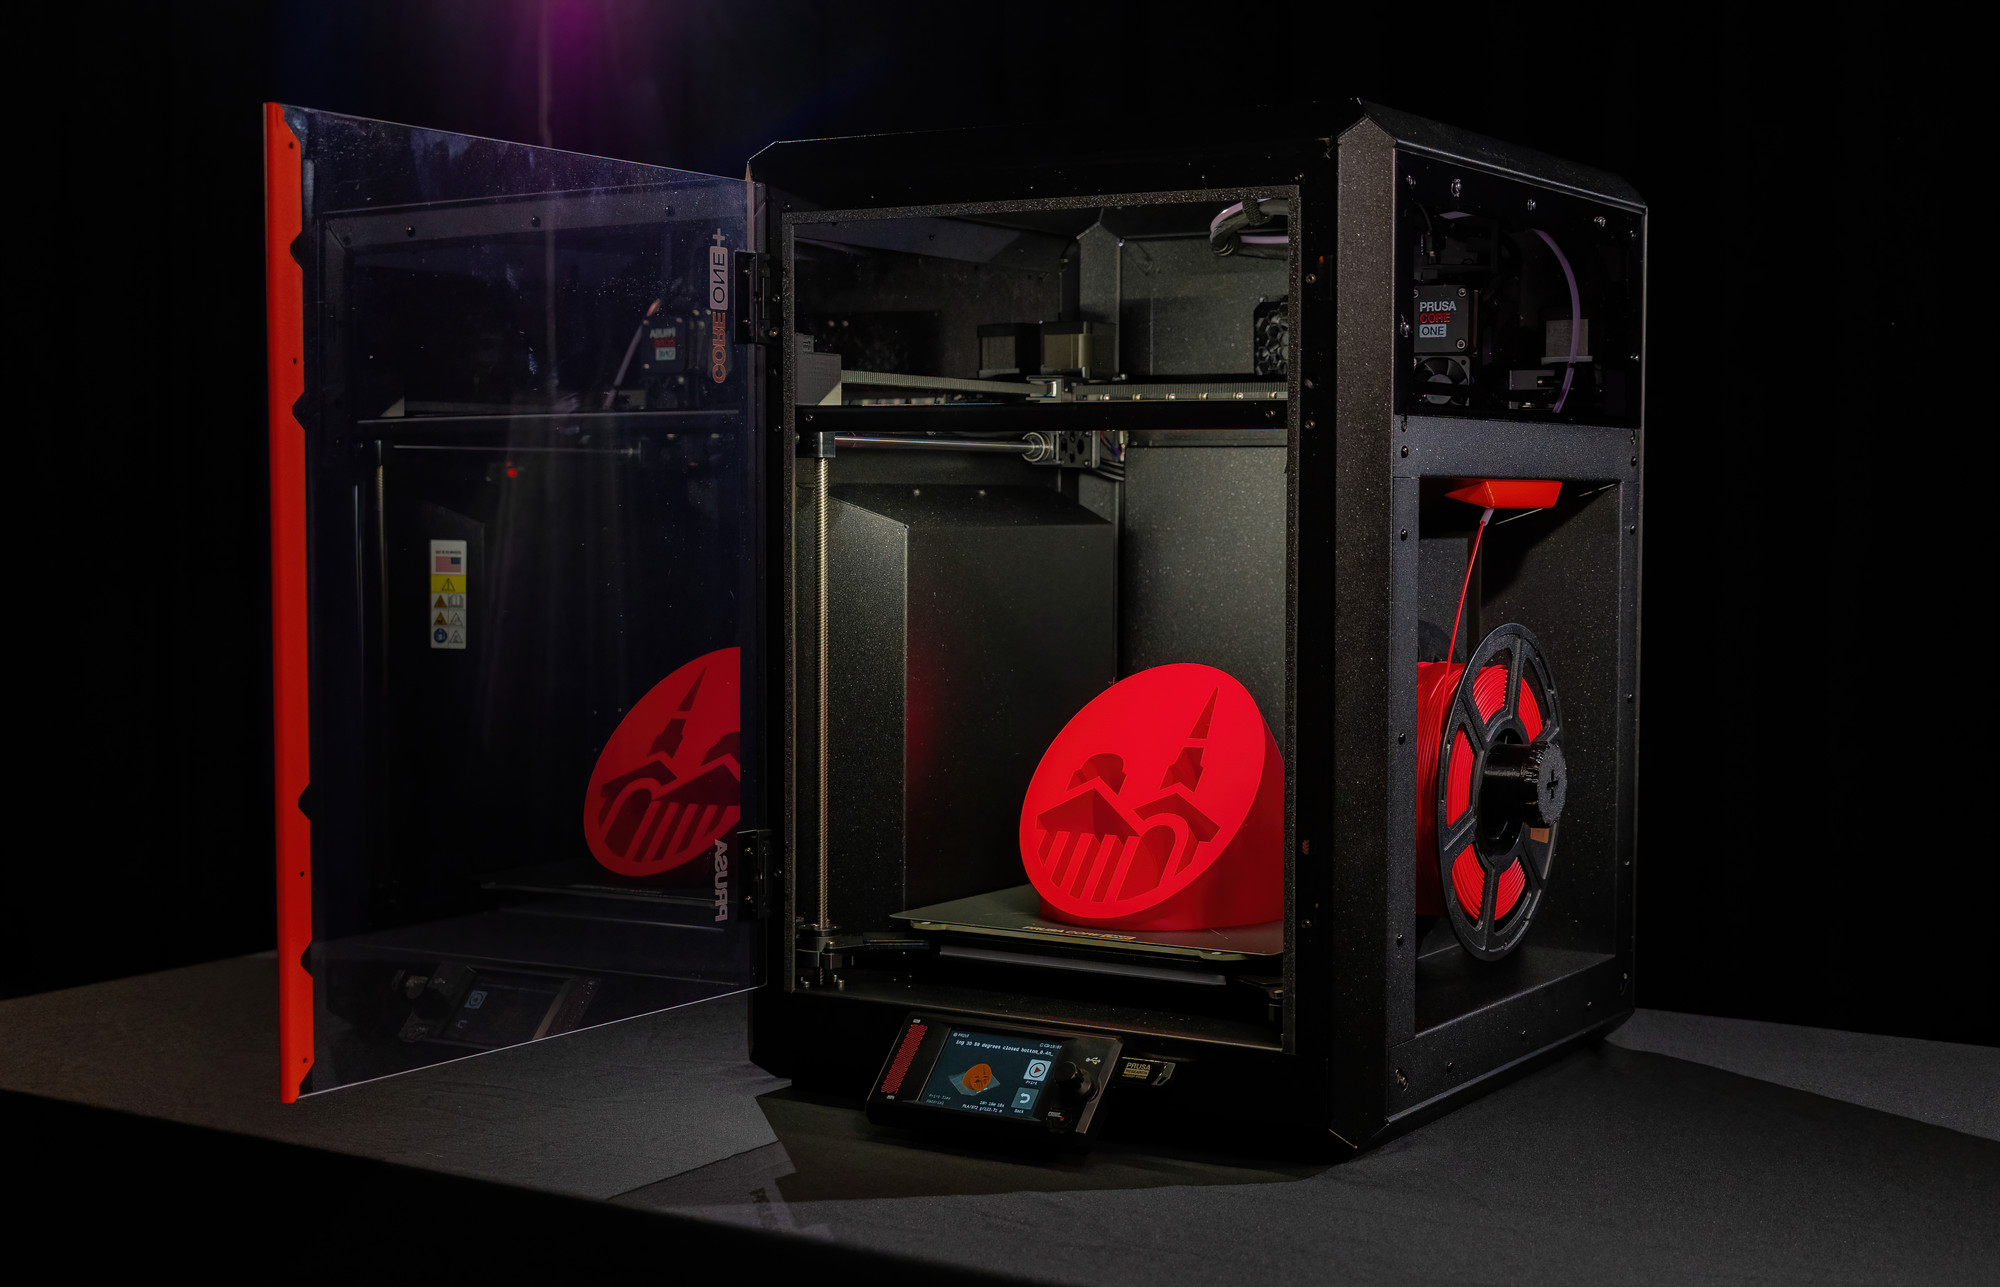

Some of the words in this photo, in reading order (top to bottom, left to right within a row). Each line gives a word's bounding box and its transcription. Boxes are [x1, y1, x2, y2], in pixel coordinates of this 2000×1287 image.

[1419, 300, 1457, 312] PRUSA
[1419, 312, 1452, 323] CORE
[1421, 326, 1445, 336] ONE
[981, 1042, 1001, 1050] degrees
[1125, 1062, 1150, 1071] PRUSA
